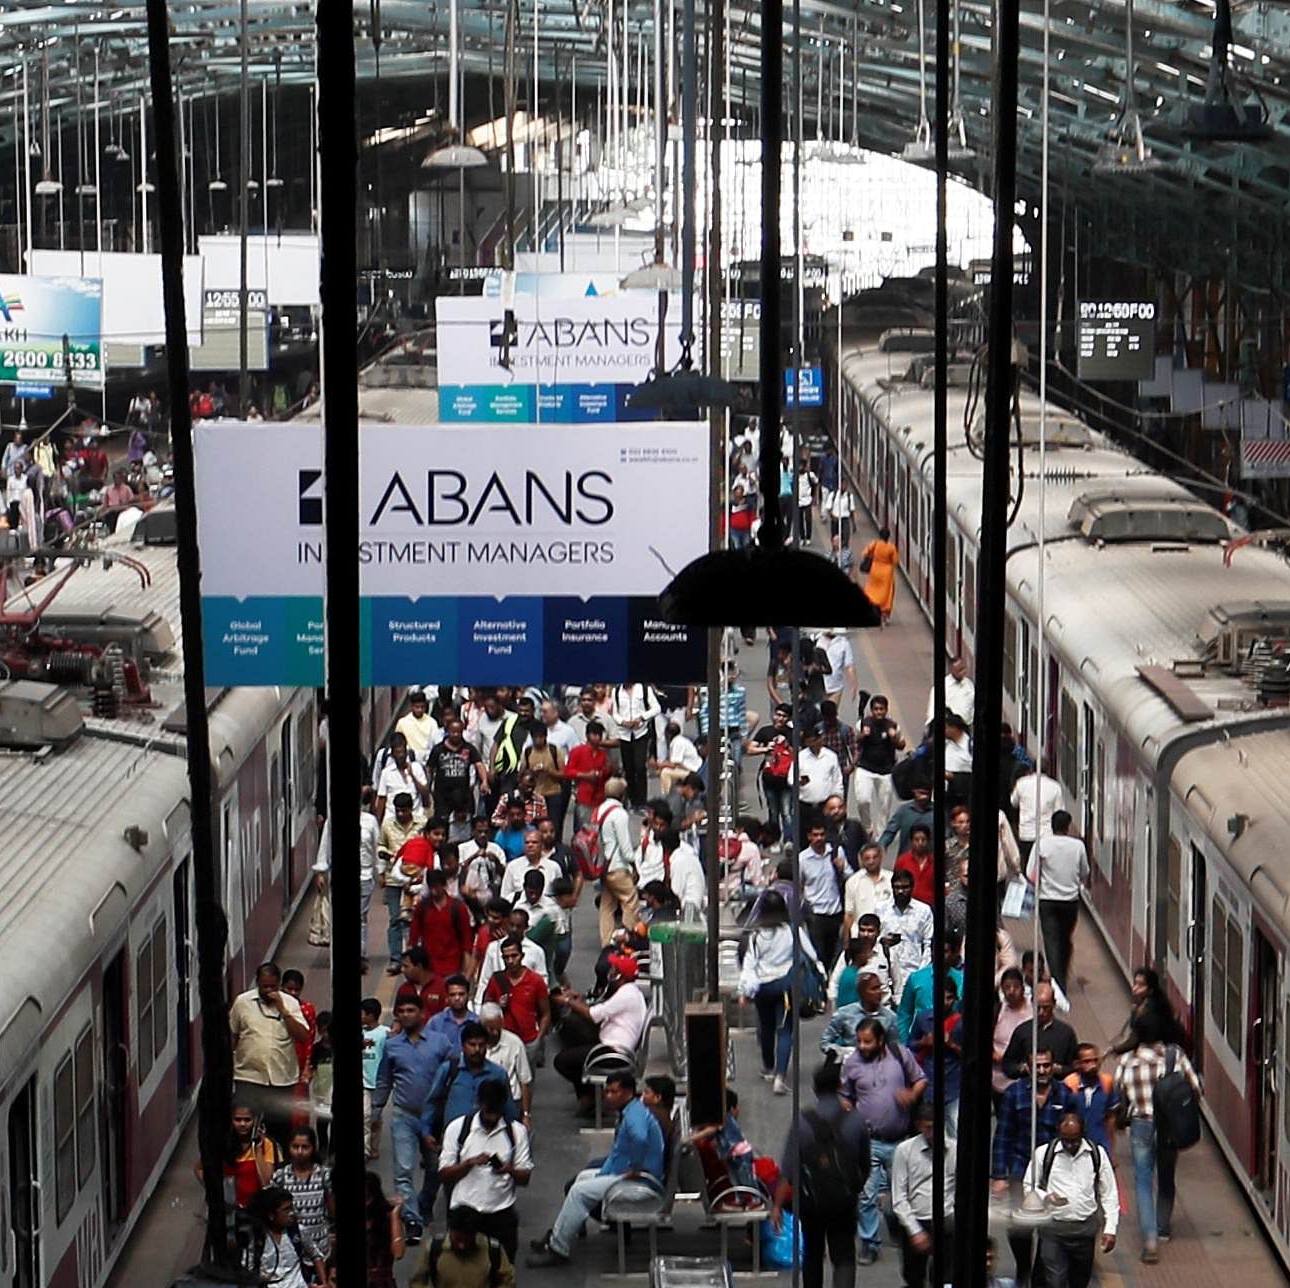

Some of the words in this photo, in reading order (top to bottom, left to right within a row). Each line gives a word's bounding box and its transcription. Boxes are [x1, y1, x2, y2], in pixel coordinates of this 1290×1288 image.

[525, 318, 651, 347] ABANS
[3, 351, 47, 369] 2600
[369, 470, 614, 527] ABANS
[297, 541, 462, 565] INSTMENT
[468, 541, 614, 565] MANAGERS
[229, 620, 262, 630] Global
[388, 620, 441, 630] Structured
[473, 620, 527, 630] Alternative
[564, 619, 606, 630] Portfolio
[222, 633, 269, 644] Arbitrage
[392, 632, 436, 643] Products
[473, 632, 526, 642] Investment
[561, 632, 608, 642] Insurance
[643, 631, 688, 642] Accounts
[234, 645, 258, 656] Fund
[488, 645, 512, 655] Fund
